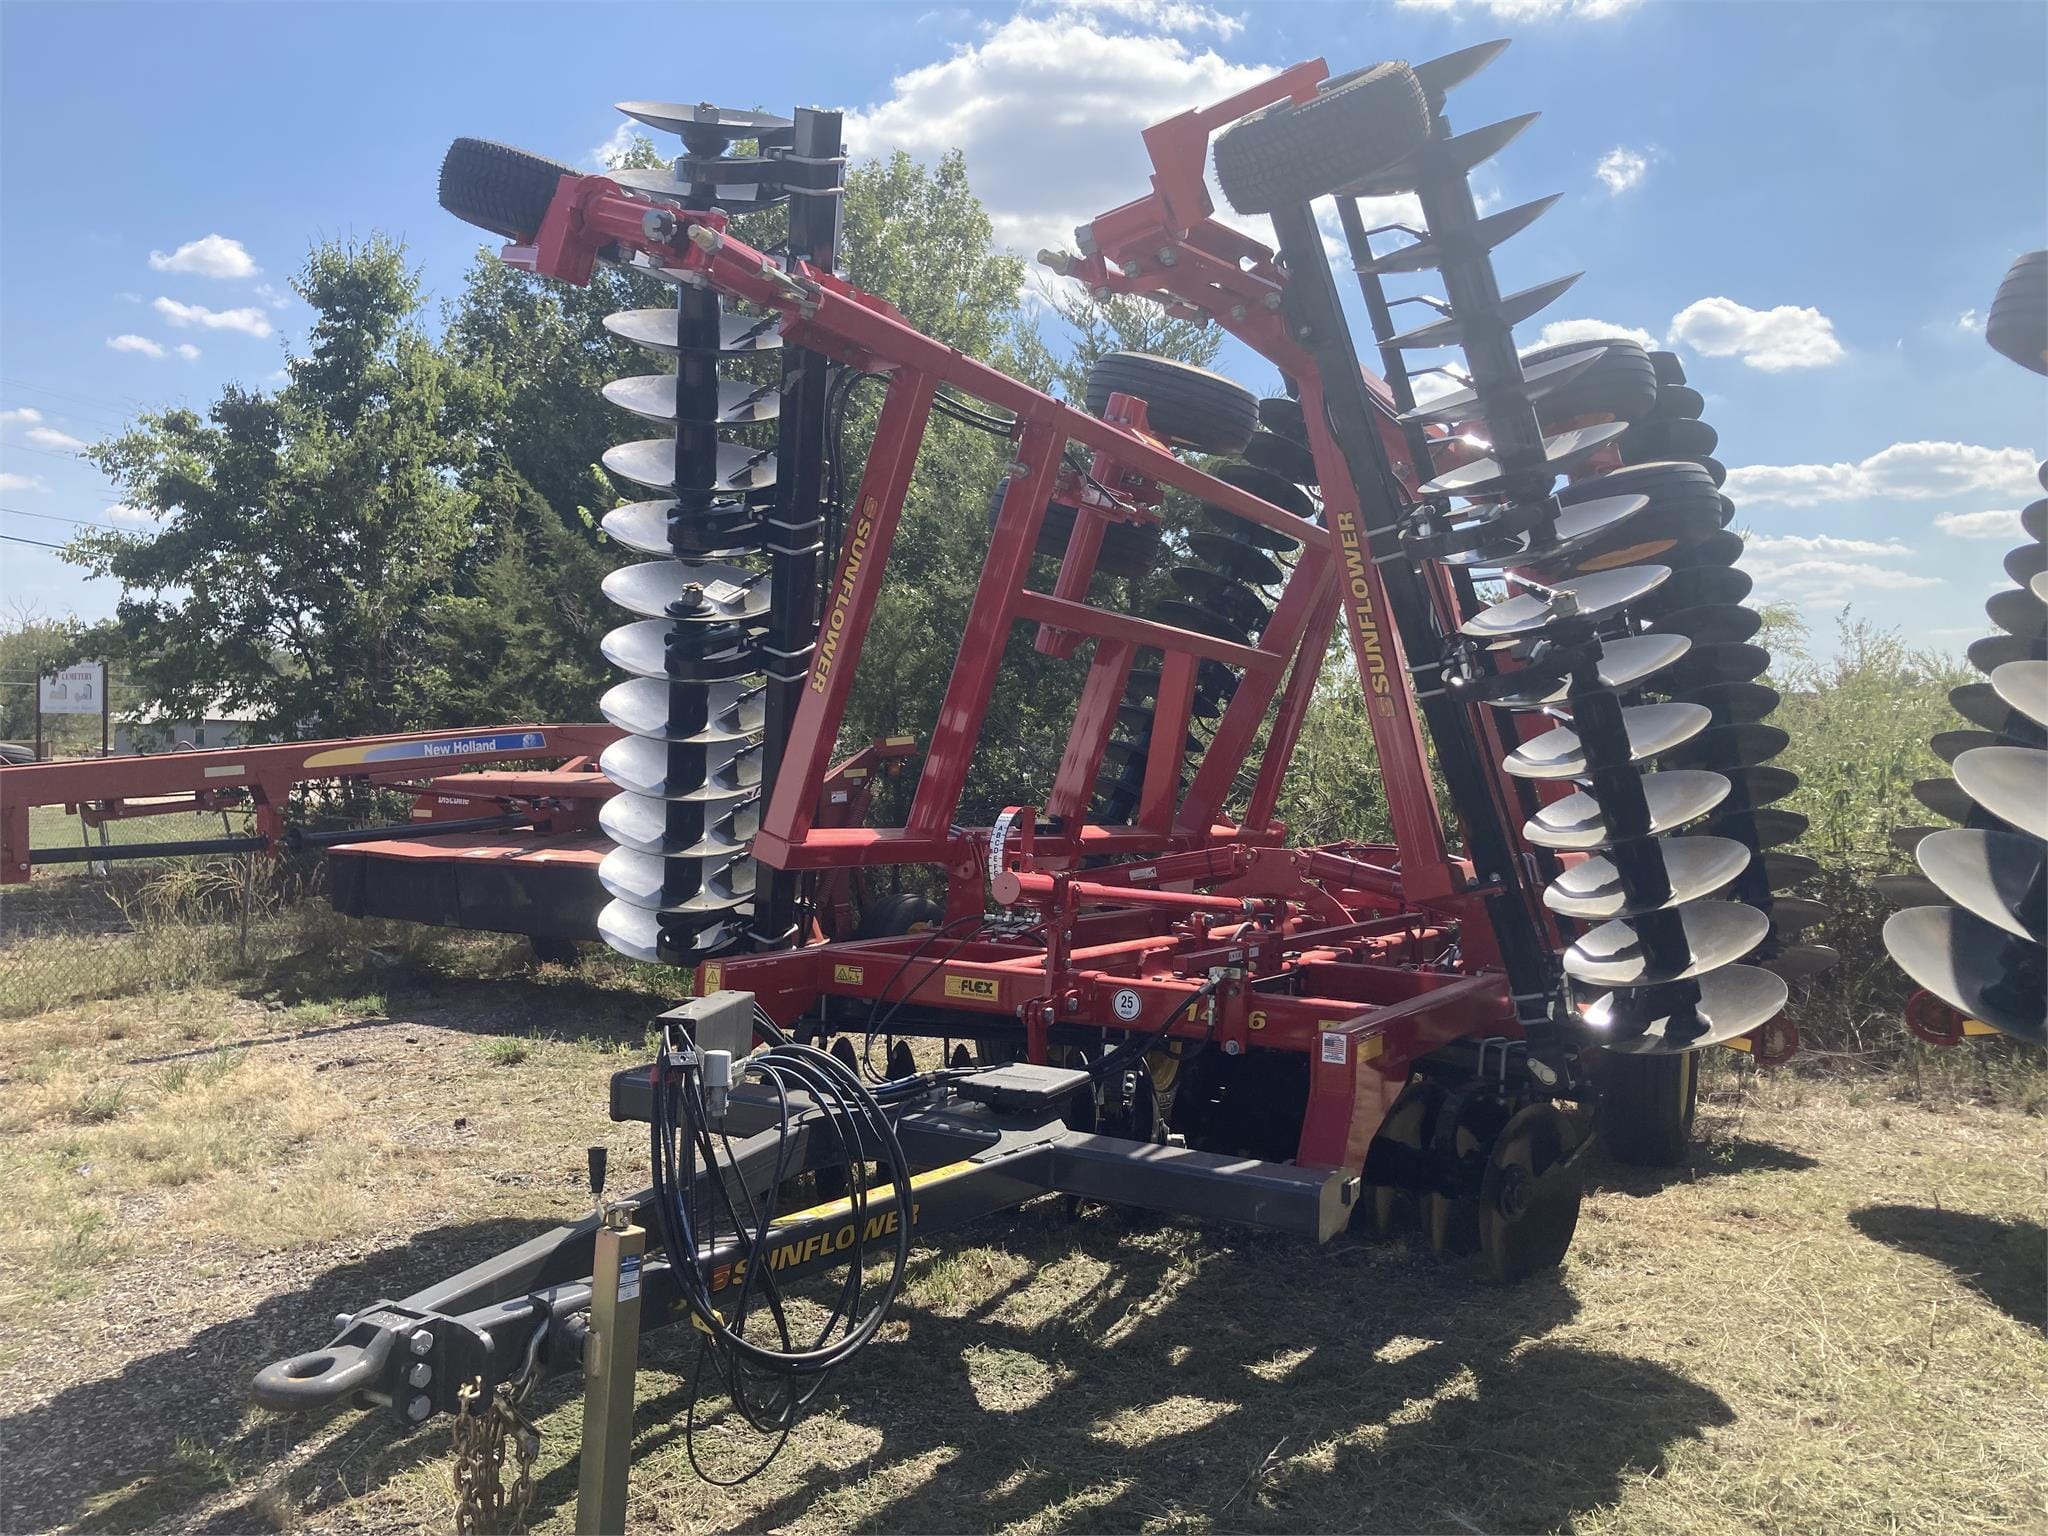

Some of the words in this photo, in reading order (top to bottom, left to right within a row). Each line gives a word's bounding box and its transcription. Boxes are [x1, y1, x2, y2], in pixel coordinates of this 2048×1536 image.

[811, 517, 871, 694] SUNFLOWER
[1337, 511, 1390, 694] SUNFLOWER
[424, 744, 451, 756] New
[453, 739, 497, 753] Holland
[1120, 995, 1133, 1009] 25
